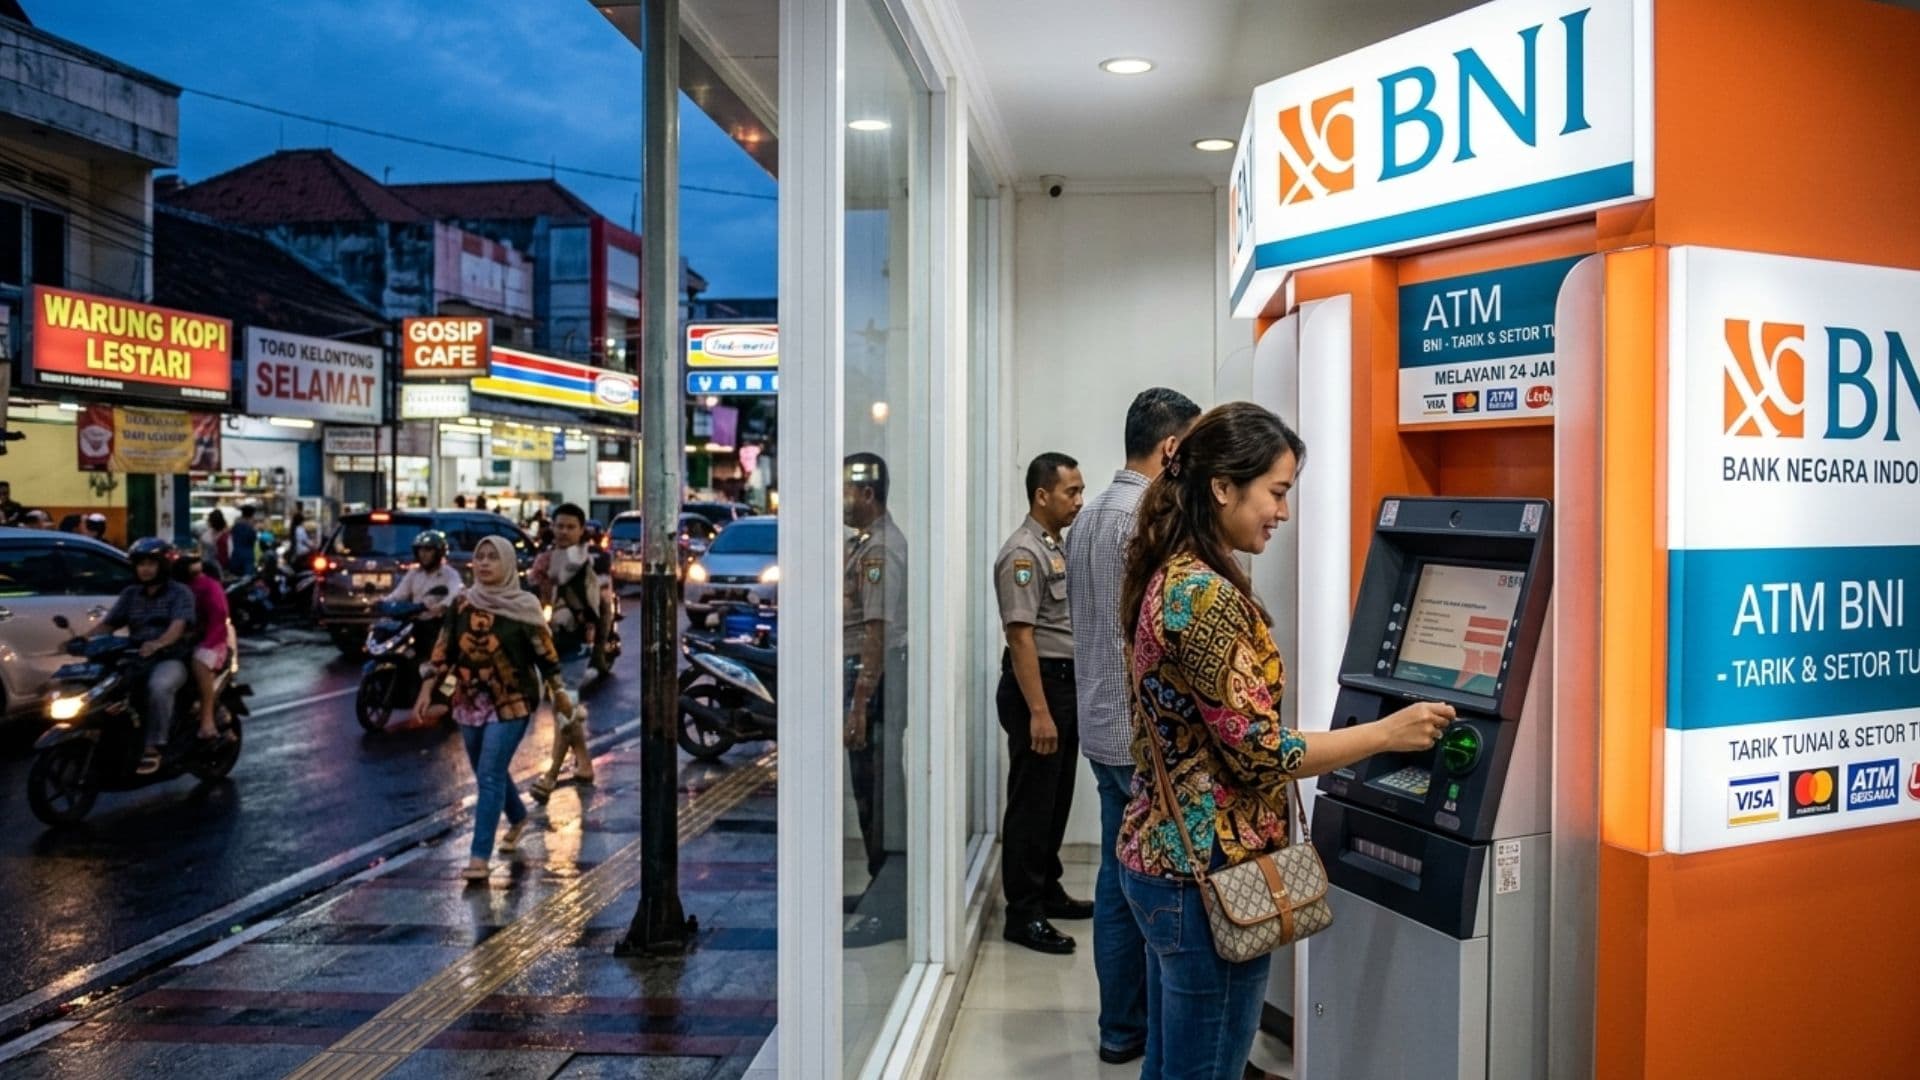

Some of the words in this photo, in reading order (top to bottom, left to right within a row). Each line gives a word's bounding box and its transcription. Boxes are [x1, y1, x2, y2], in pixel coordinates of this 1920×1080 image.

[1377, 7, 1592, 183] BNI
[44, 293, 164, 342] WARUNG
[170, 316, 226, 352] KOPI
[1422, 284, 1501, 331] ATM
[409, 321, 483, 343] GOSIP
[1423, 338, 1443, 353] BNI
[1499, 326, 1539, 344] SETOR
[86, 338, 191, 380] LESTARI
[301, 344, 374, 369] KELONTONG
[415, 346, 477, 367] CAFE
[256, 361, 376, 407] SELAMAT
[1435, 365, 1505, 386] MELAYANI
[1510, 364, 1527, 379] 24
[1723, 456, 1780, 482] BANK
[1786, 458, 1869, 483] NEGARA
[1874, 459, 1920, 485] INDO
[1732, 581, 1825, 636] ATM
[1841, 578, 1904, 630] BNI
[1732, 657, 1796, 688] TARIK
[1801, 655, 1818, 683] &
[1823, 650, 1891, 682] SETOR
[1729, 737, 1779, 762] TARIK
[1782, 730, 1834, 756] TUNAI
[1839, 728, 1850, 750] &
[1854, 722, 1906, 748] SETOR
[1909, 721, 1920, 742] T
[1851, 765, 1896, 791] ATM
[1736, 788, 1774, 811] VISA
